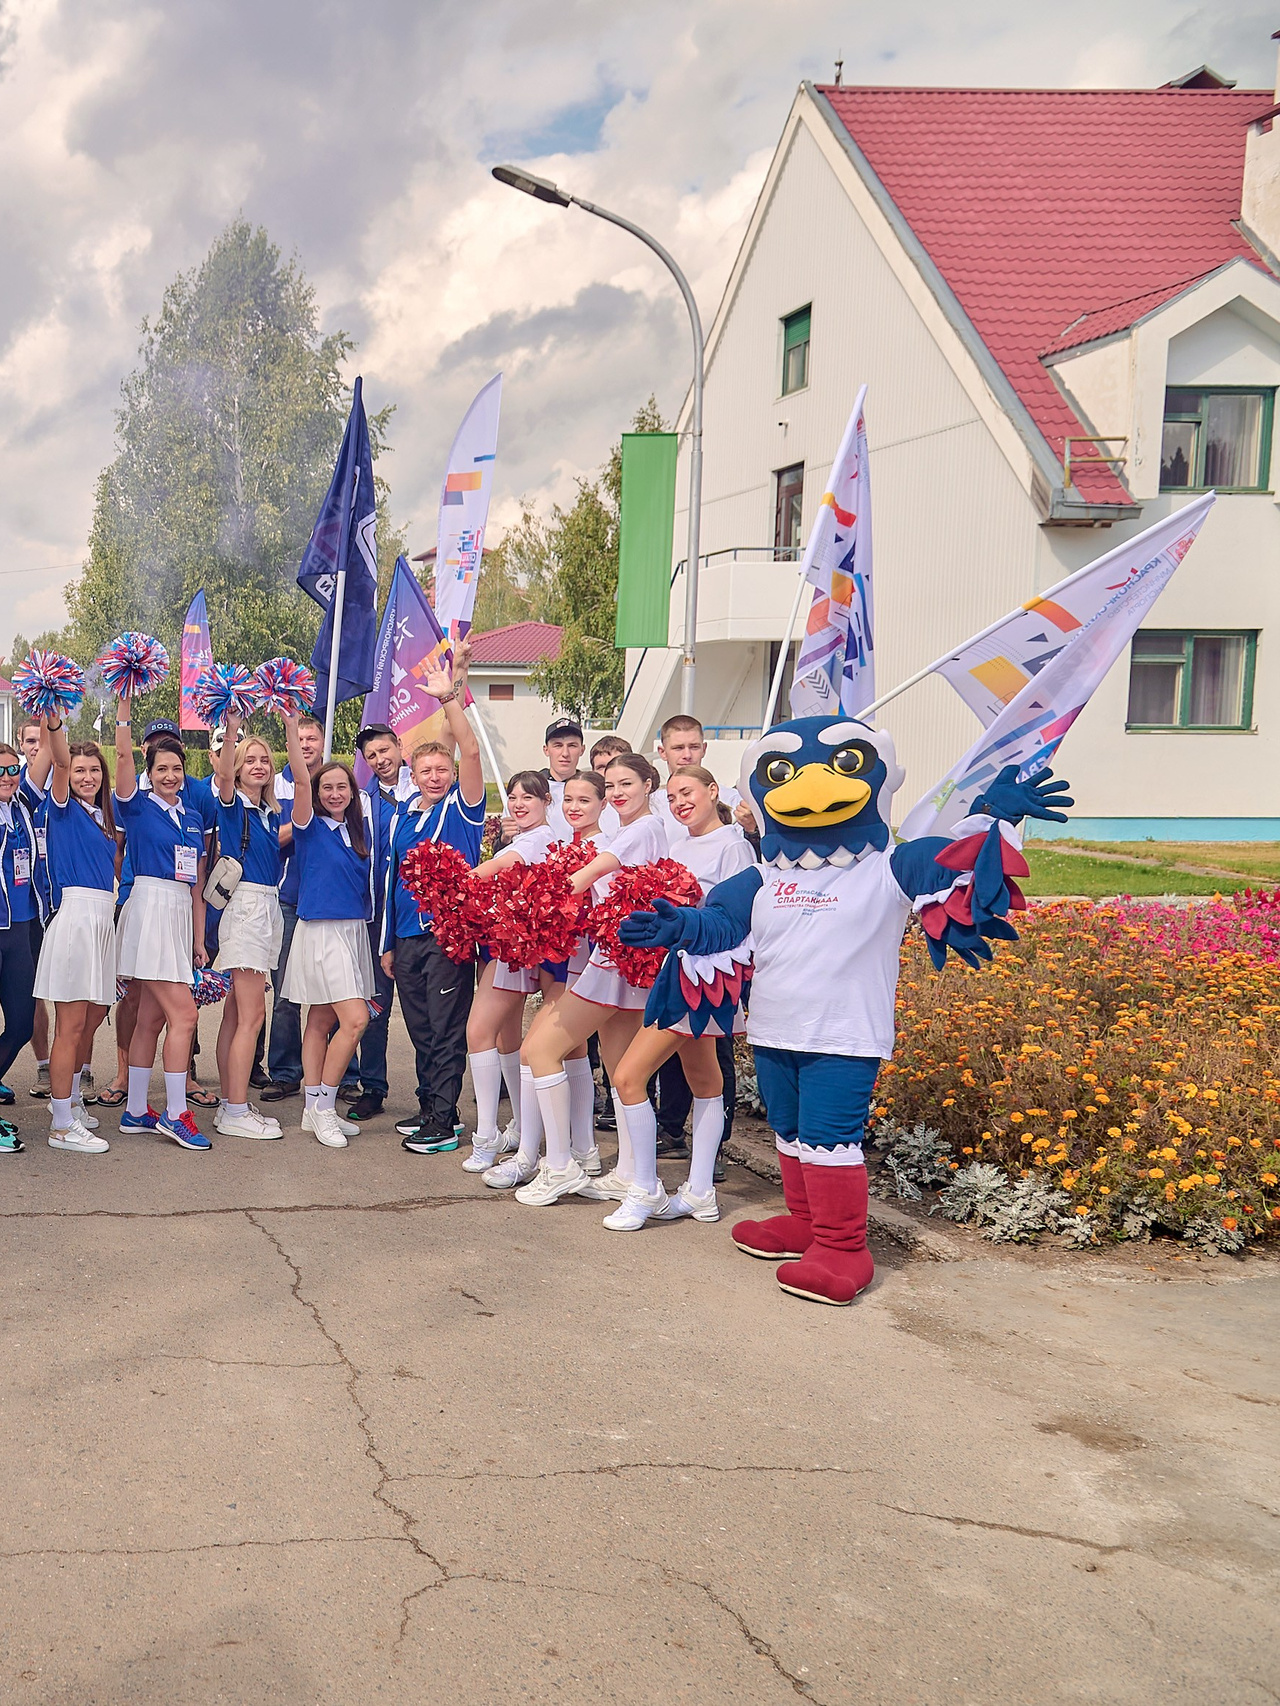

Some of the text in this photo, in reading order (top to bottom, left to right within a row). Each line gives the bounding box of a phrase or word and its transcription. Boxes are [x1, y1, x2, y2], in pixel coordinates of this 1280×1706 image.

[151, 723, 173, 731] BOSS
[774, 882, 798, 897] 18
[777, 896, 839, 904] СПАРТАКИАДА
